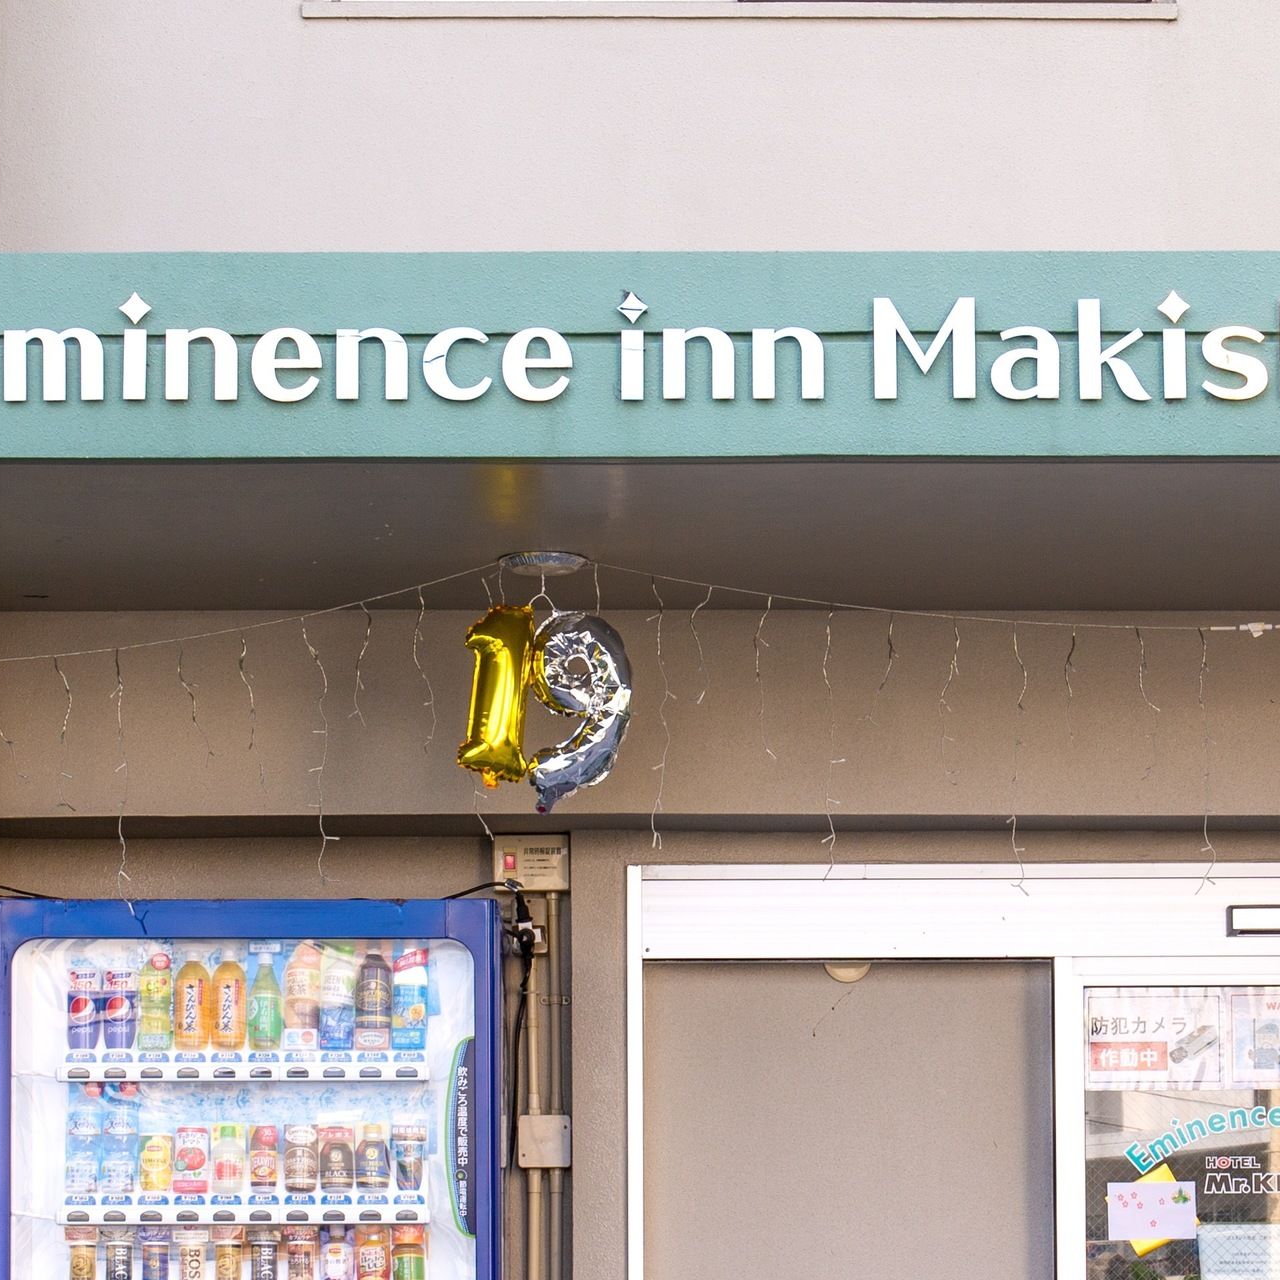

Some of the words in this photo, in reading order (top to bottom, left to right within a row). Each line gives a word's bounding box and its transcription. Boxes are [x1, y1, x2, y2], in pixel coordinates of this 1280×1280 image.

[616, 290, 825, 402] inn
[183, 983, 198, 1033] さんぴん茶
[219, 983, 234, 1033] さんぴん茶
[71, 1026, 94, 1034] pepsi
[107, 1026, 130, 1034] pepsi
[1090, 1016, 1187, 1036] 防犯カメラ
[1099, 1047, 1158, 1068] 作動中
[457, 1066, 469, 1167] 飲みごろ温度で販売中
[1205, 1156, 1261, 1169] HOTEL
